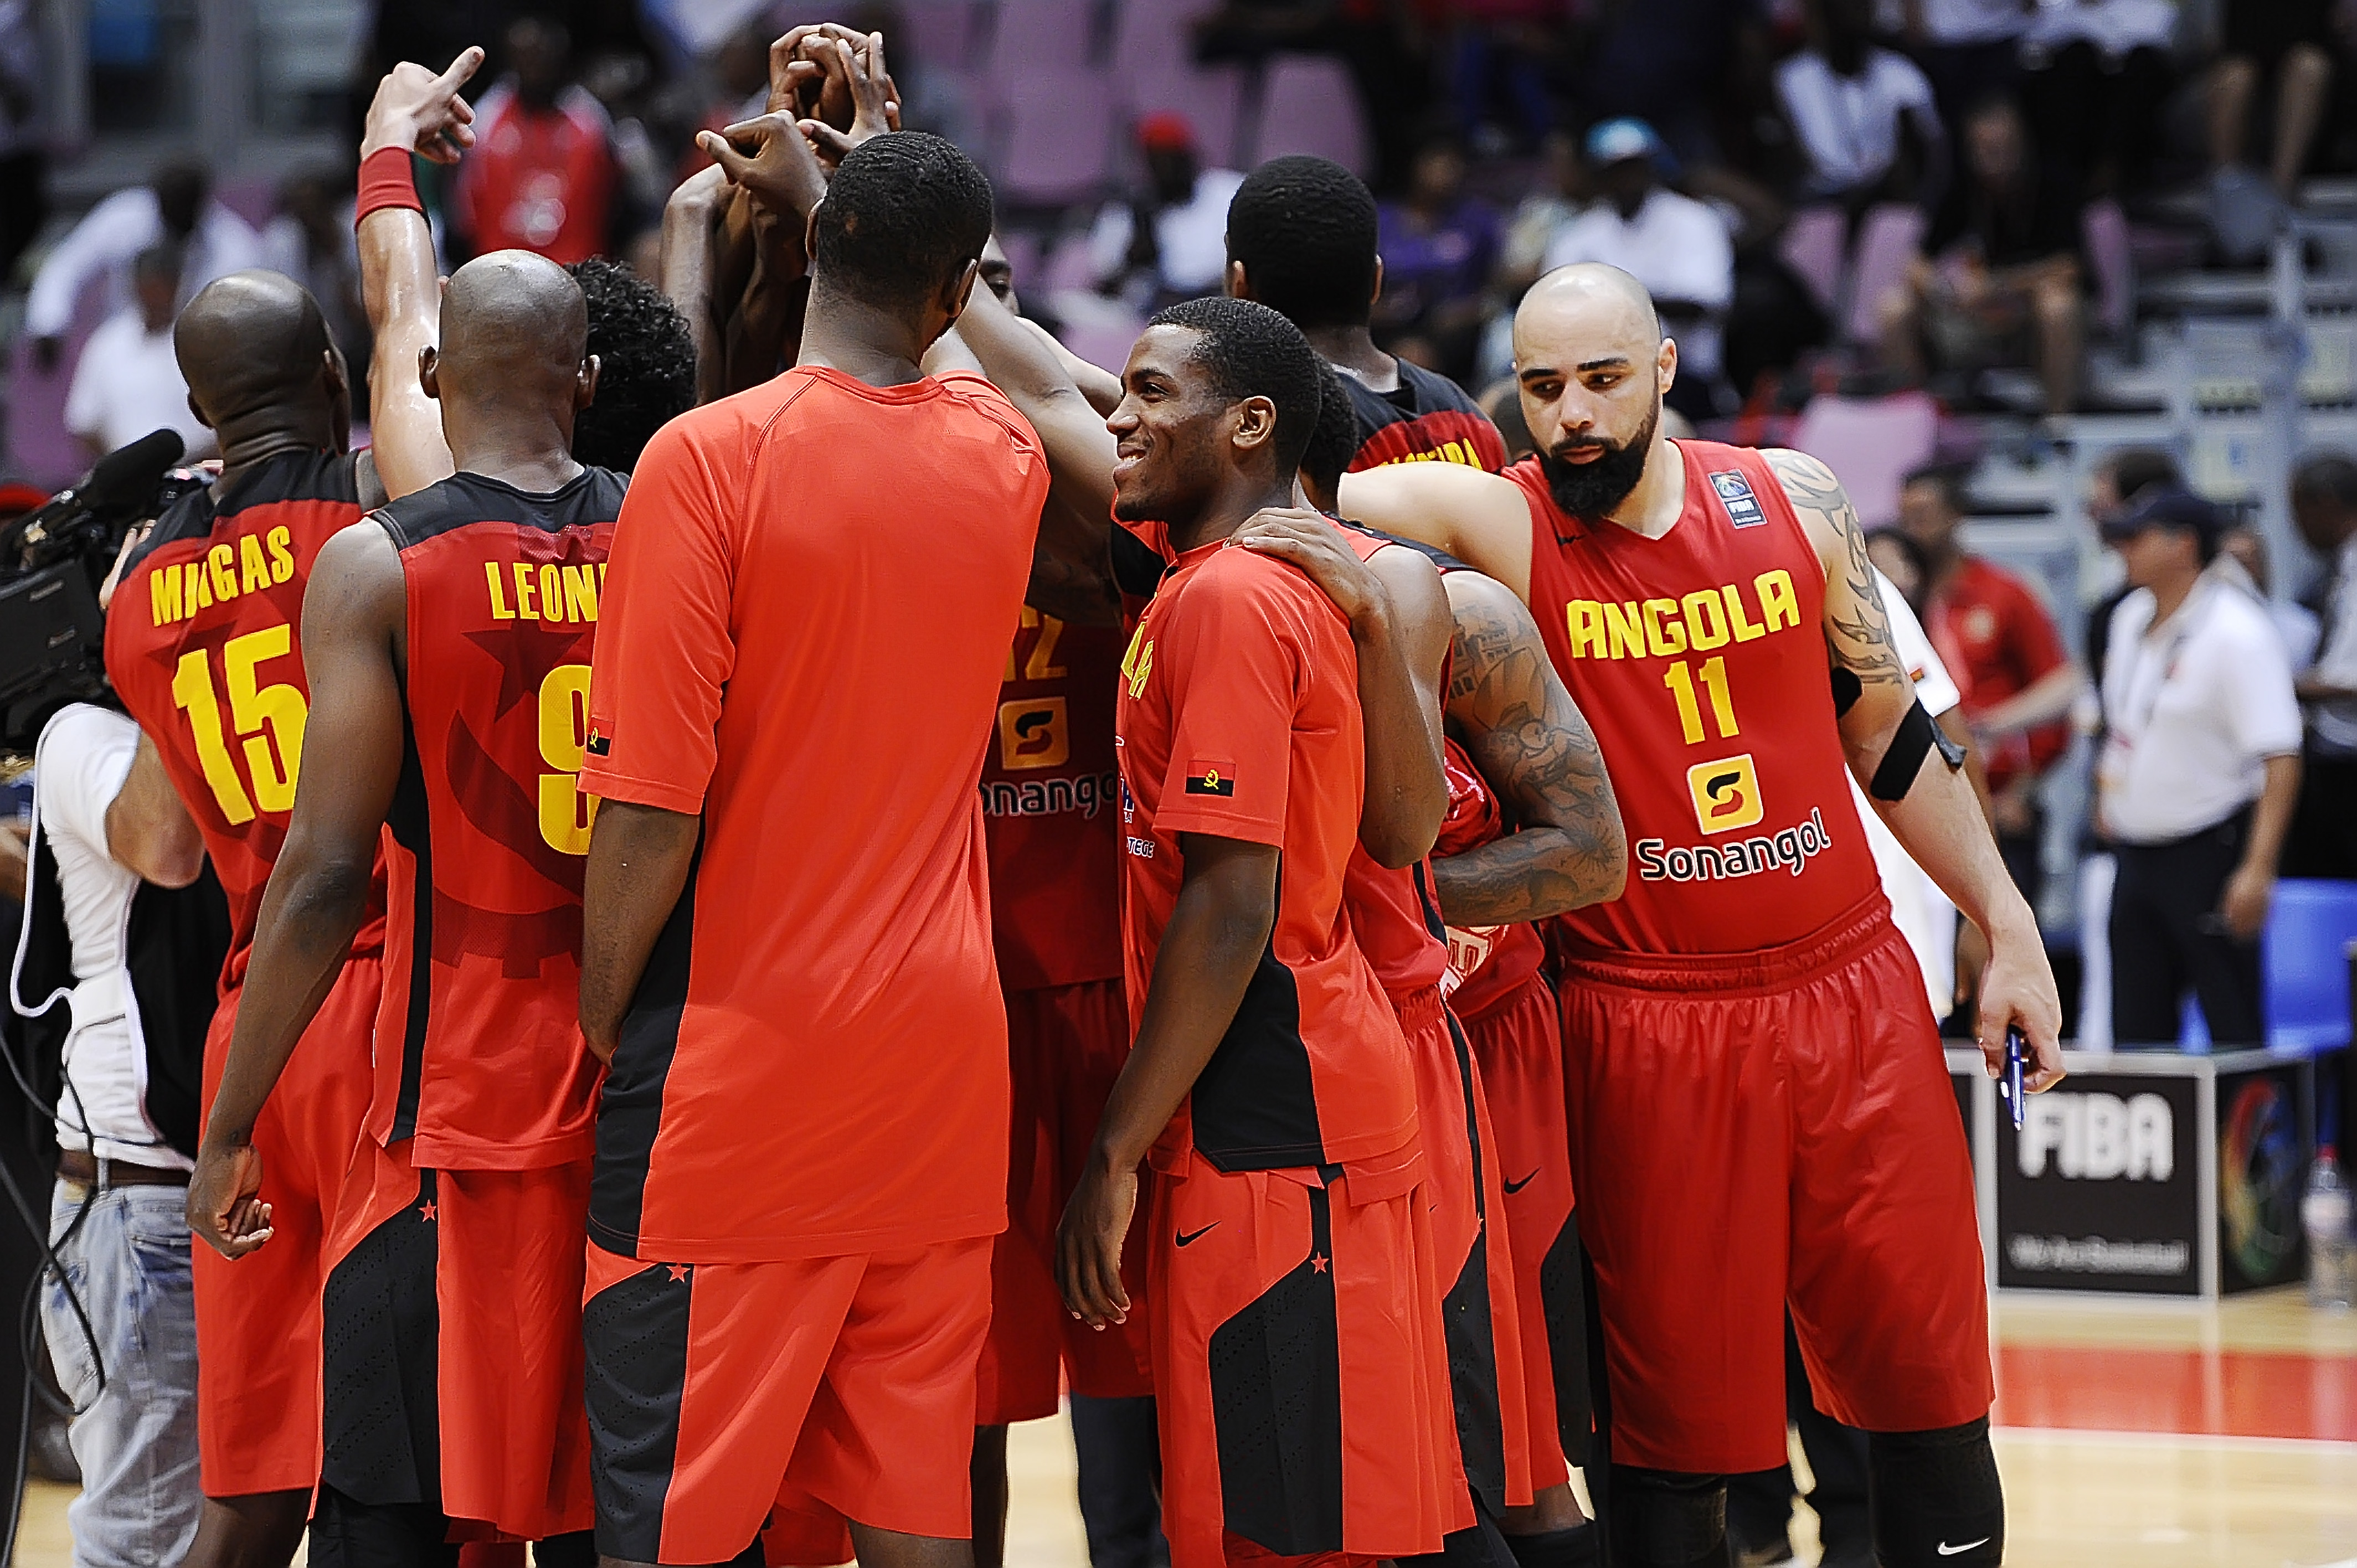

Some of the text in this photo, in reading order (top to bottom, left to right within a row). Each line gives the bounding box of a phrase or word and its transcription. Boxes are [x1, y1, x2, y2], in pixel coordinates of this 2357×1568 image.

[1003, 605, 1068, 682] 2
[1567, 569, 1800, 659] ANGOLA
[172, 623, 308, 825] 15
[1664, 656, 1740, 745] 11
[979, 770, 1117, 819] nango
[1126, 837, 1155, 858] TEGE
[1636, 807, 1831, 881] Sonangol
[2017, 1092, 2173, 1183] FIBA
